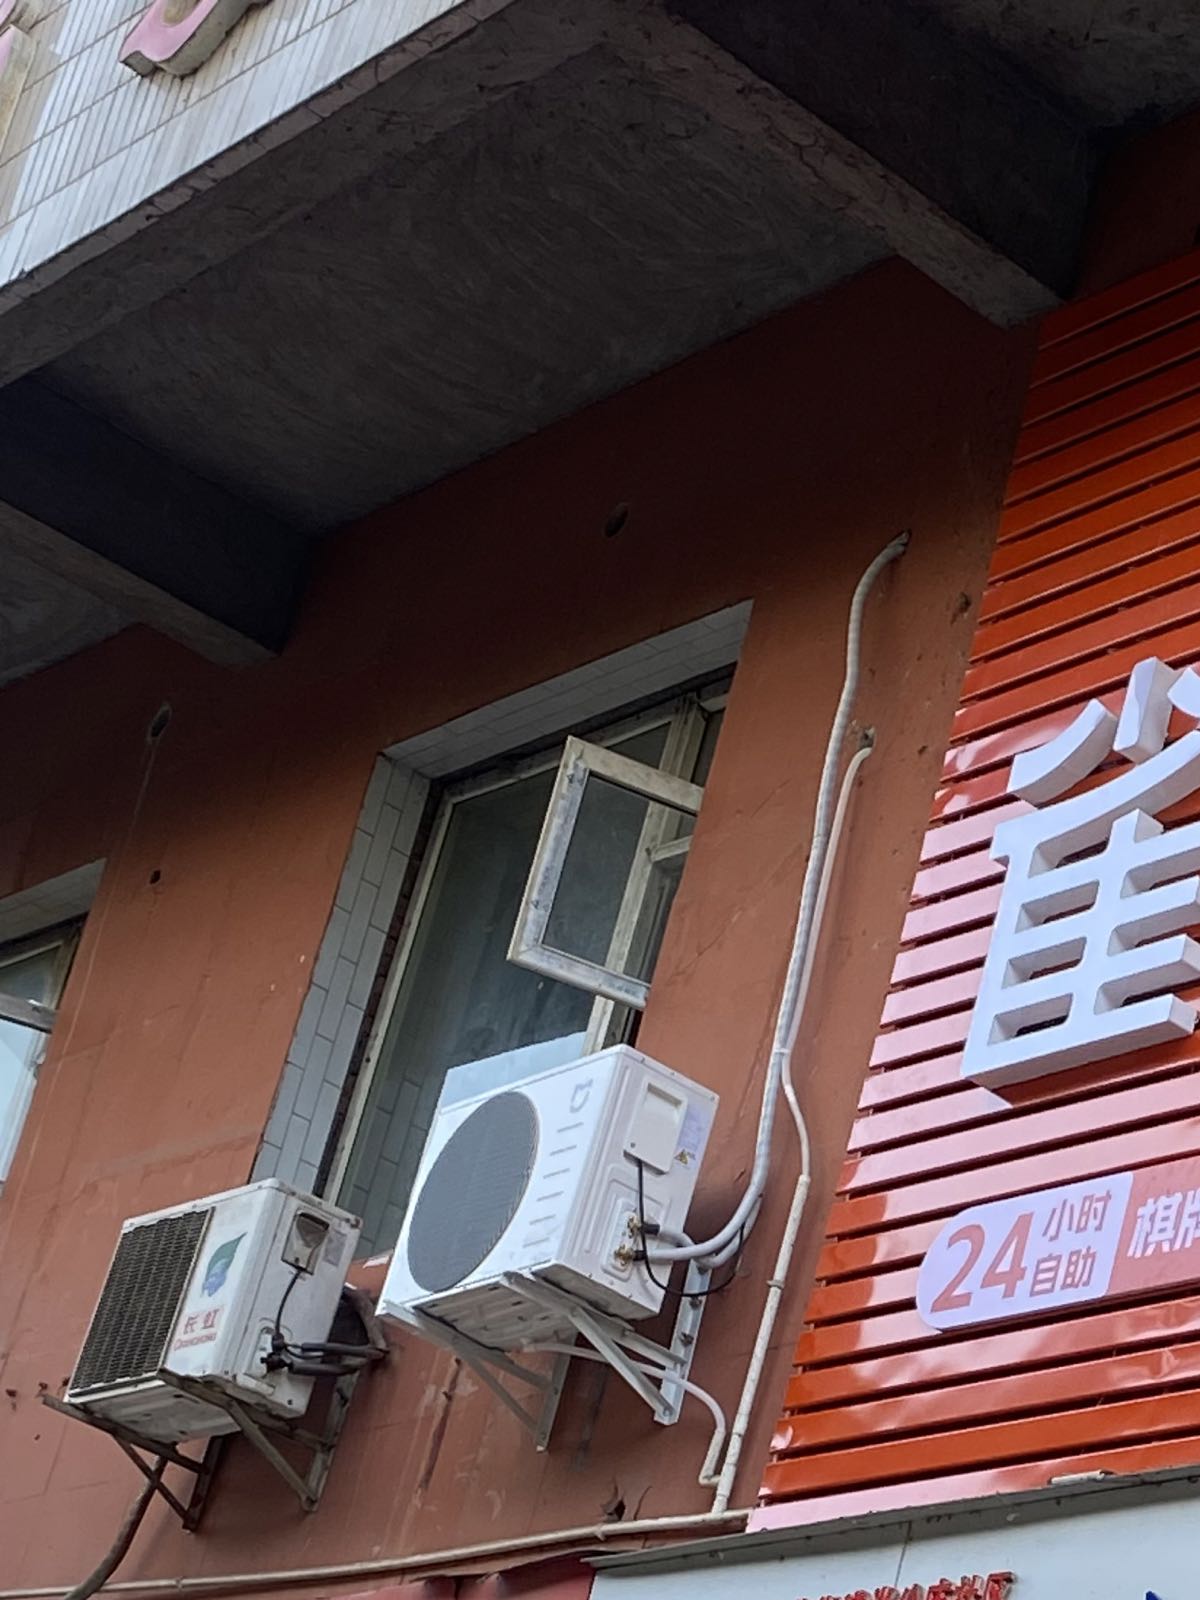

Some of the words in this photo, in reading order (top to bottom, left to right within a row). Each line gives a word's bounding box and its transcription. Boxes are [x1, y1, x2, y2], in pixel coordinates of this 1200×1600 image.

[931, 1213, 1029, 1317] 24
[1041, 1189, 1114, 1242] 小时
[1029, 1244, 1098, 1295] 自助
